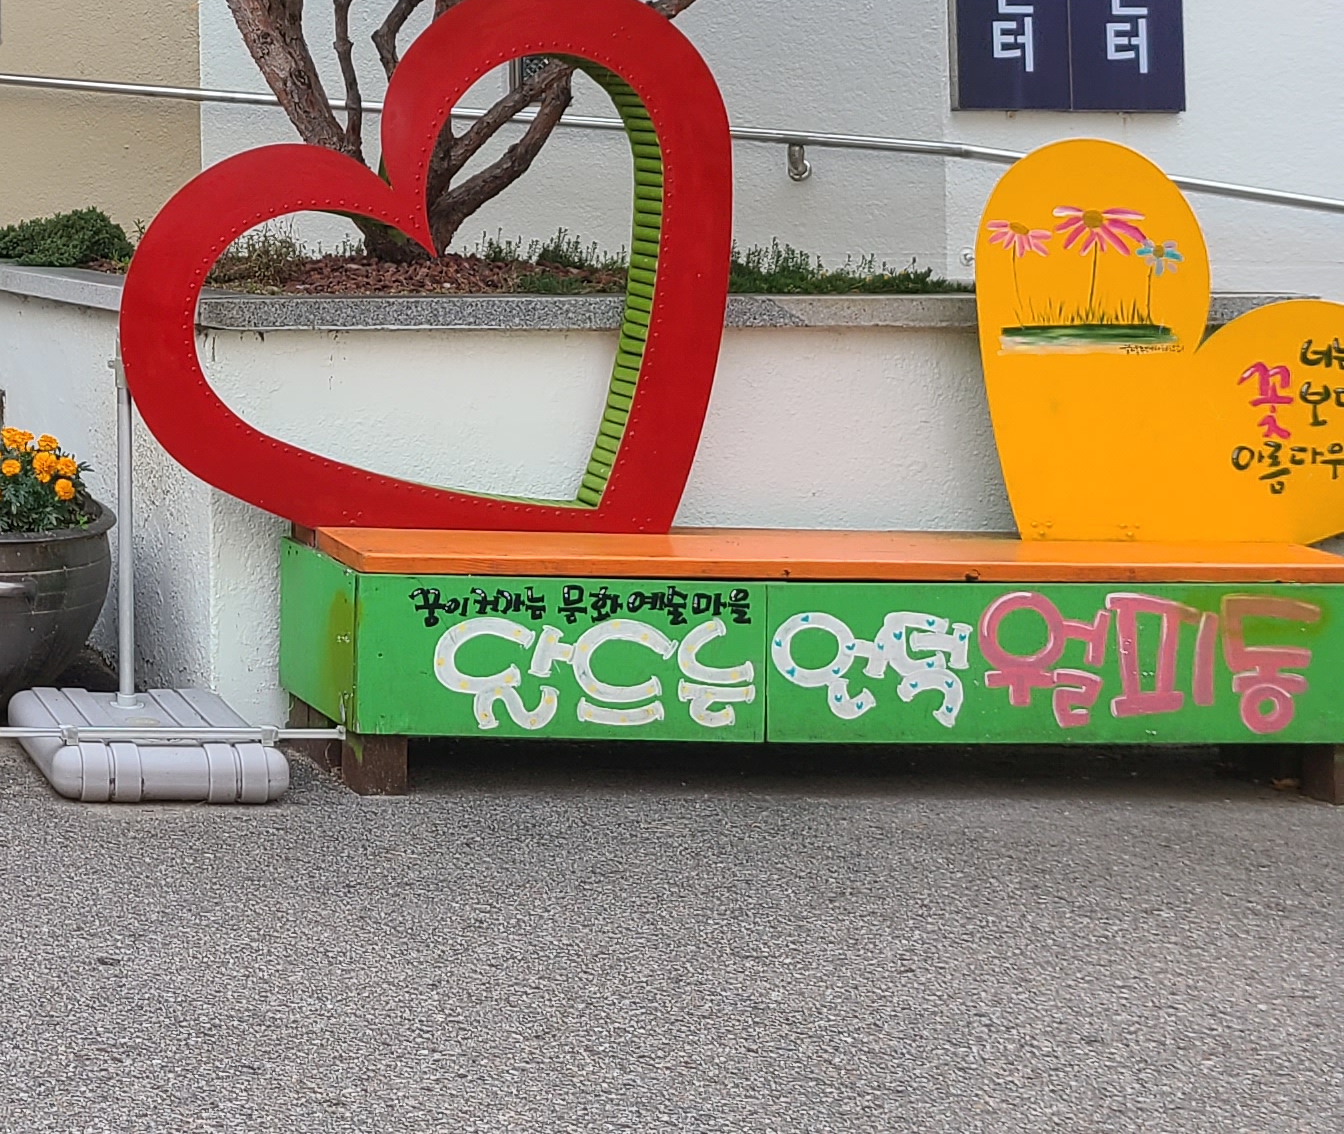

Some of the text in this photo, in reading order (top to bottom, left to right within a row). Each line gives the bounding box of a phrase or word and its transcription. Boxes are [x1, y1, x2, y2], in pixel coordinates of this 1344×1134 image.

[1236, 361, 1294, 440] 꽃
[771, 611, 973, 728] 언덕
[977, 591, 1321, 734] 월피동
